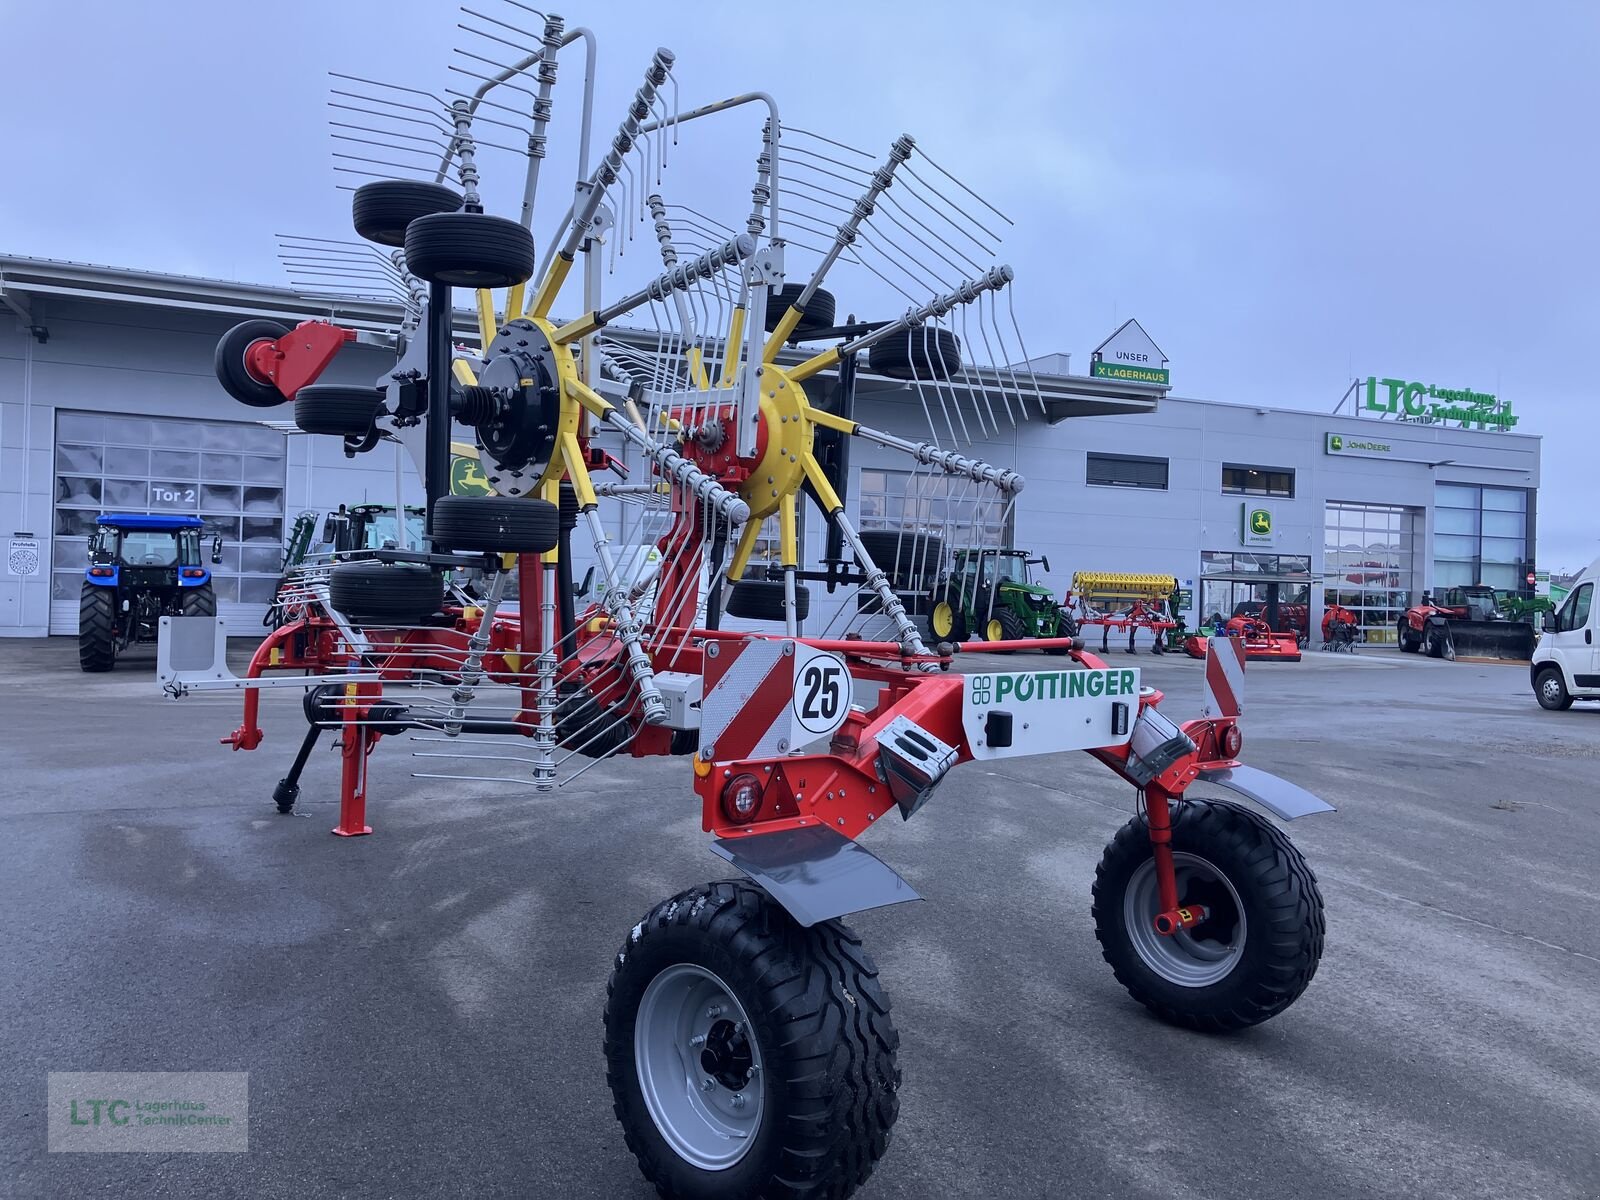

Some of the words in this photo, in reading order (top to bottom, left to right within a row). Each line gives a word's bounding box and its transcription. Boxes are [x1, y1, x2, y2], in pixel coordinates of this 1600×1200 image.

[1116, 351, 1149, 363] UNSER
[1107, 367, 1165, 383] LAGERHAUS
[1366, 376, 1427, 416] LTC
[1429, 384, 1497, 405] Lagerhaus
[1346, 440, 1367, 450] JOHN
[1367, 442, 1391, 452] DEERE
[152, 487, 181, 502] Tor
[184, 489, 195, 502] 2
[802, 666, 841, 720] 25
[995, 669, 1135, 703] PÖTTINGER
